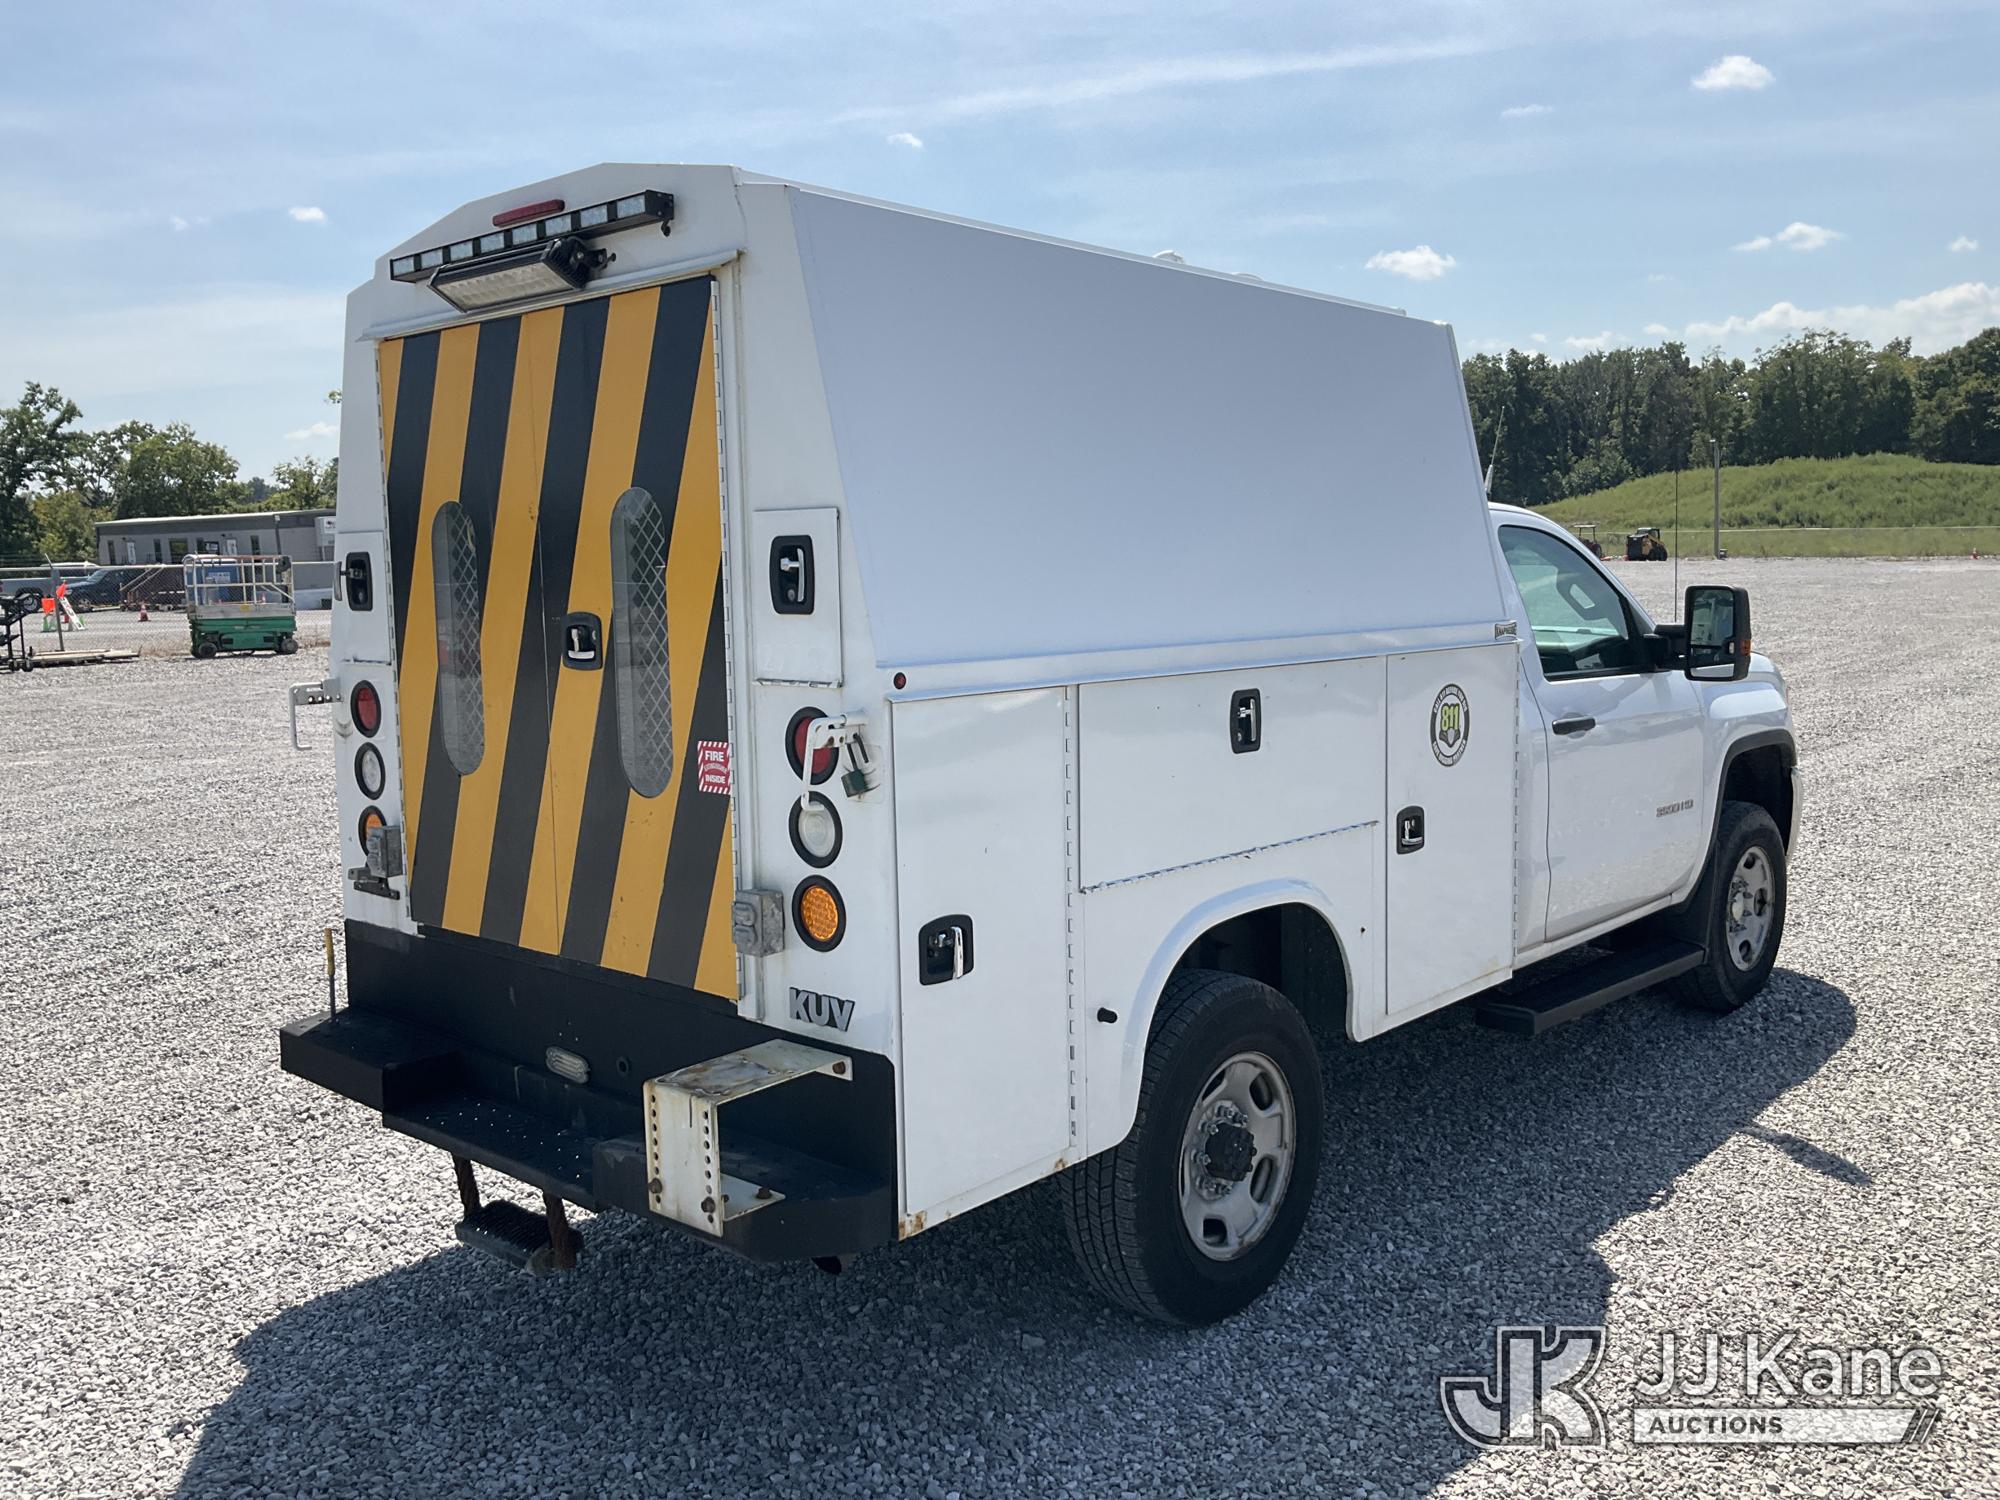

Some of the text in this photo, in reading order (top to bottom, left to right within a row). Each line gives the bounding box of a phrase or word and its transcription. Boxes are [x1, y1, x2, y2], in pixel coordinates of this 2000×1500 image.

[1441, 703, 1460, 731] 811
[704, 750, 725, 762] FIRE
[705, 774, 726, 784] INSIDE
[789, 986, 856, 1032] KUV
